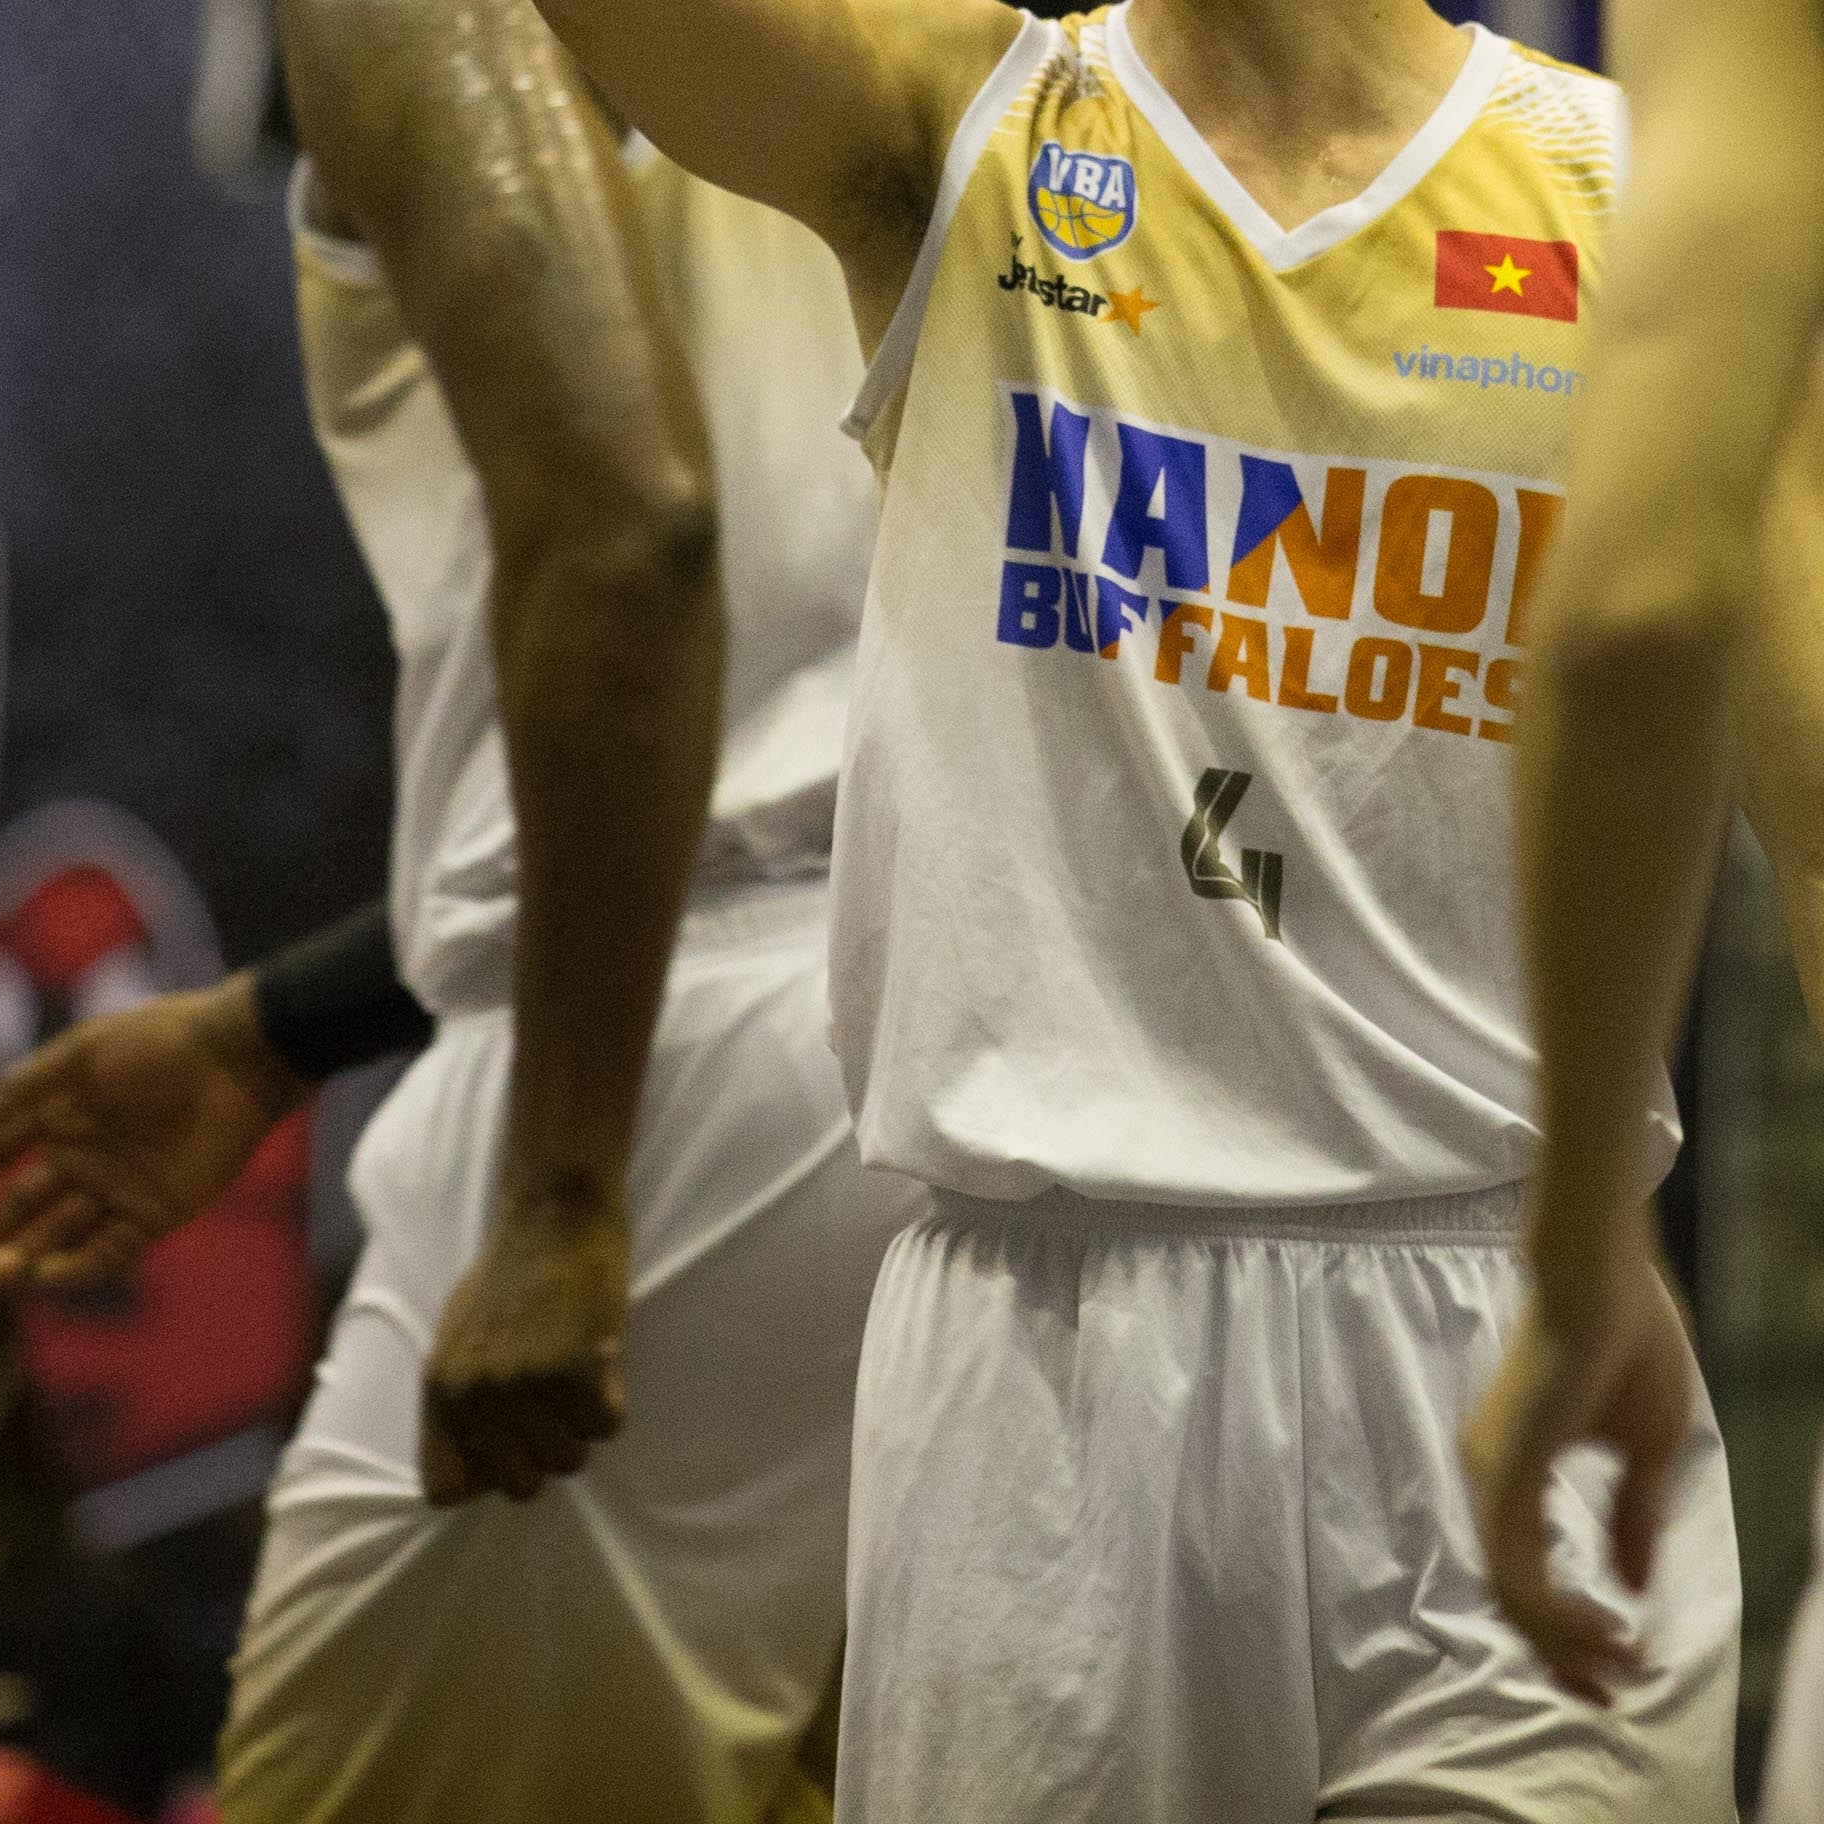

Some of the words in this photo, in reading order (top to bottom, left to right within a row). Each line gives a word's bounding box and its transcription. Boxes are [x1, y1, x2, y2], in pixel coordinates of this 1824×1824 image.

[1048, 146, 1126, 209] VBA
[1392, 343, 1590, 397] vinaphon
[1005, 392, 1567, 647] HANOI
[996, 559, 1522, 745] BUFFALOES
[1181, 767, 1283, 941] 4
